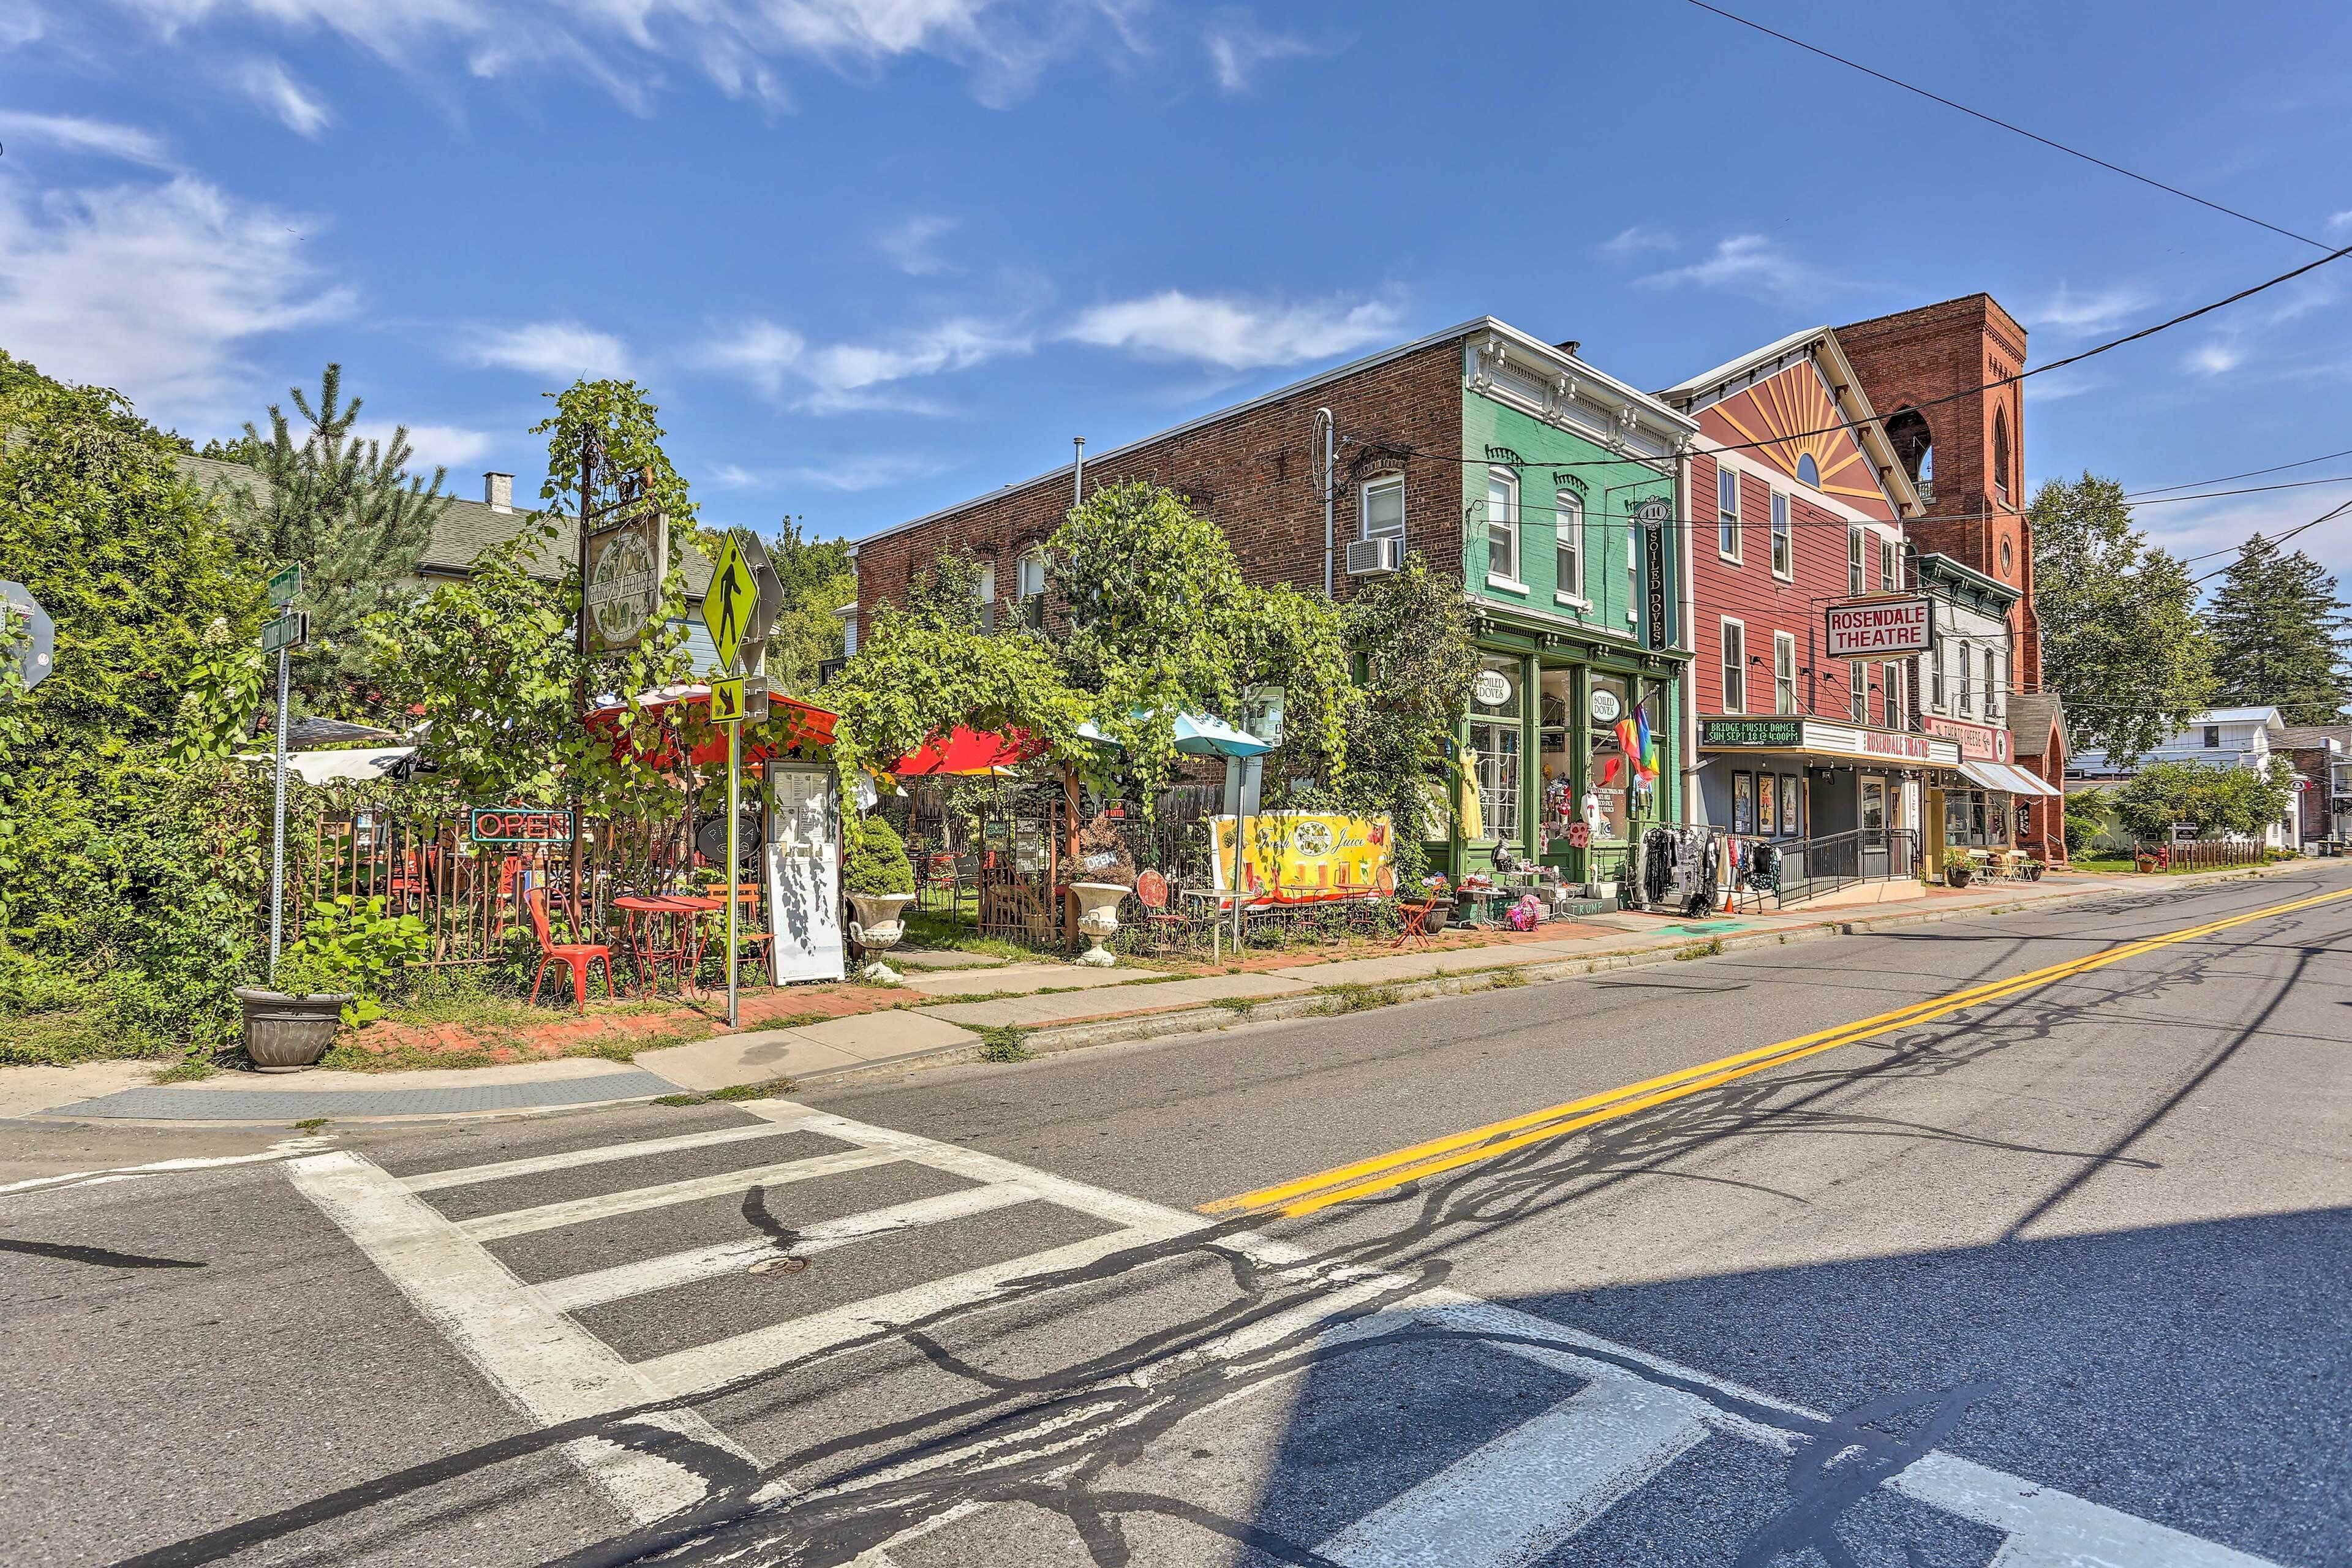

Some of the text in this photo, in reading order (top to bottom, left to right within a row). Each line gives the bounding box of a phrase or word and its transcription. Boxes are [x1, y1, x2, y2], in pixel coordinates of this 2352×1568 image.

[1643, 507, 1663, 519] 410
[623, 571, 651, 594] HOUSE
[1650, 532, 1661, 641] SOILED DOVES
[1832, 606, 1924, 630] ROSENDALE
[1836, 627, 1921, 648] THEATRE
[1479, 687, 1504, 699] DOVES
[1594, 695, 1615, 707] SOILED
[1594, 706, 1615, 715] DOVES
[1709, 732, 1724, 741] SUN
[1769, 733, 1798, 741] 4:00PM
[1711, 723, 1796, 732] BRIDGE MUSIC DANCE
[1867, 732, 1929, 758] ROSENDALE THEATRE
[1964, 729, 1981, 747] CHEESE
[478, 814, 567, 837] OPEN
[1256, 827, 1365, 854] Fresh Juice
[1571, 902, 1603, 915] TRUMP
